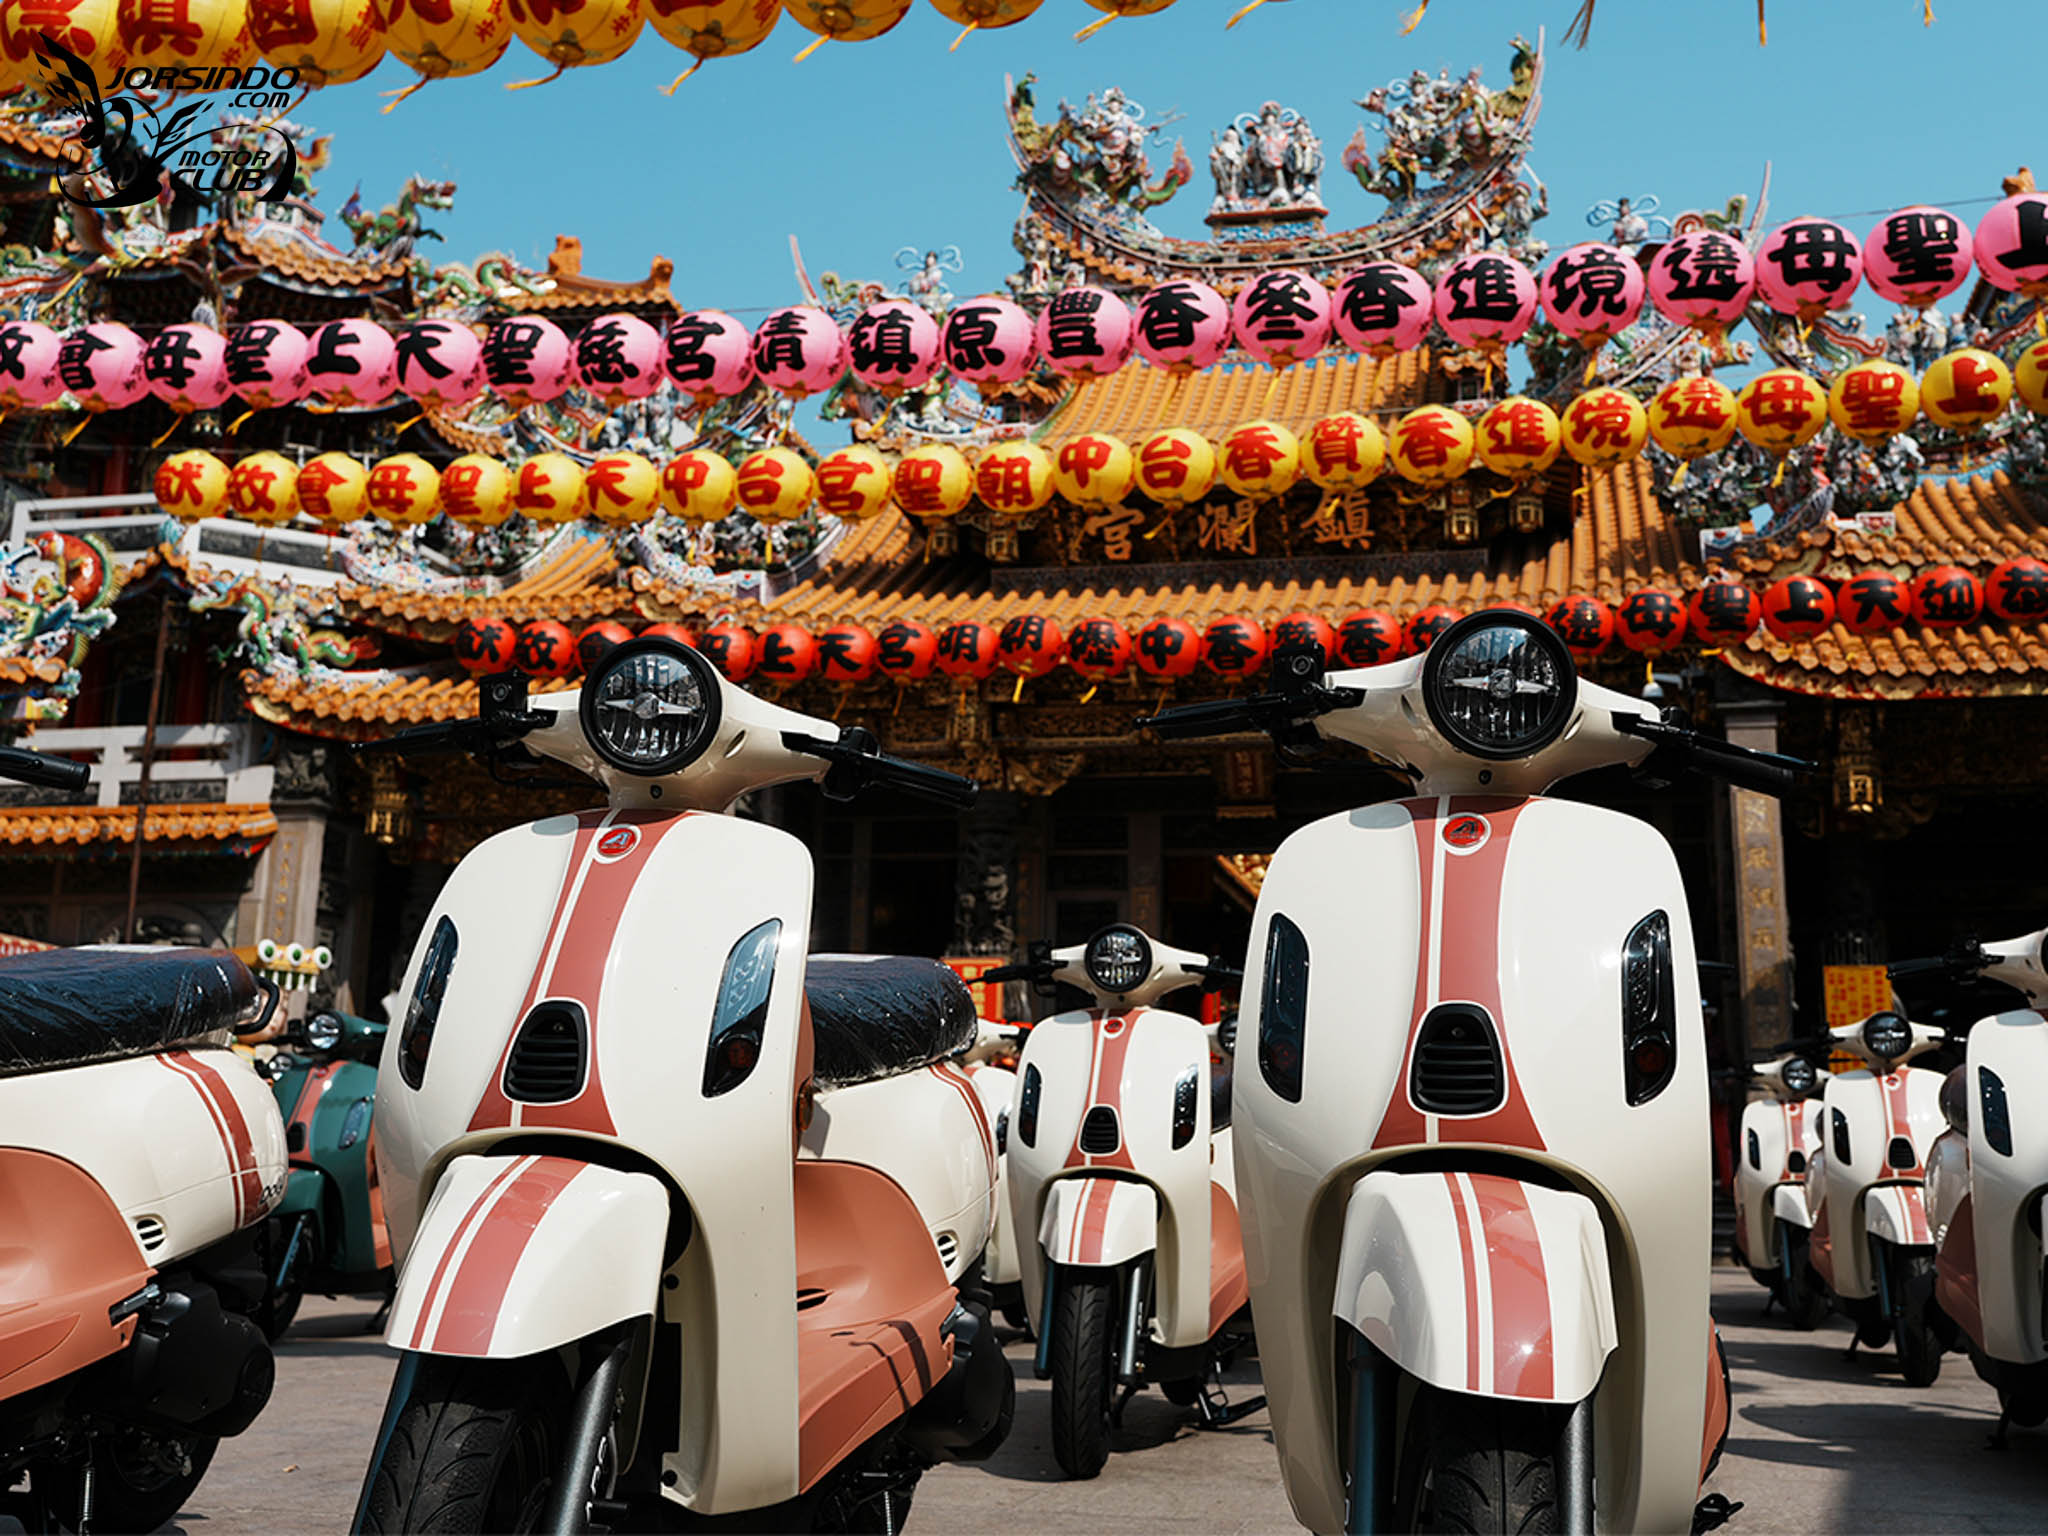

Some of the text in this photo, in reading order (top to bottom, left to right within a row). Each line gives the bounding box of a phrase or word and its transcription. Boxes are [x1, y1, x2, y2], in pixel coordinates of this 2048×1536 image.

[1768, 223, 1857, 292] 母
[1883, 213, 1958, 285] 聖
[1340, 264, 1416, 331] 香
[1445, 258, 1522, 321] 進
[1550, 249, 1627, 316] 境
[752, 311, 808, 374] 清
[946, 307, 1005, 371] 原
[1138, 283, 1209, 350] 香
[146, 330, 201, 388] 母
[306, 322, 361, 375] 上
[395, 324, 452, 385] 天
[482, 322, 544, 385] 聖
[666, 315, 725, 381] 宮
[1742, 375, 1814, 430] 母
[1841, 370, 1904, 428] 聖
[1936, 357, 1999, 414] 上
[1398, 412, 1461, 469] 香
[1484, 402, 1551, 456] 進
[1570, 392, 1632, 449] 境
[663, 454, 709, 508] 中
[737, 454, 784, 506] 台
[1058, 436, 1112, 489] 中
[1141, 436, 1191, 488] 台
[1226, 426, 1286, 480] 香
[513, 462, 556, 508] 上
[585, 460, 634, 508] 天
[817, 454, 874, 512] 宮
[1774, 581, 1825, 623] 上
[1850, 579, 1899, 623] 天
[758, 632, 796, 673] 上
[818, 634, 861, 672] 天
[1141, 624, 1185, 669] 中
